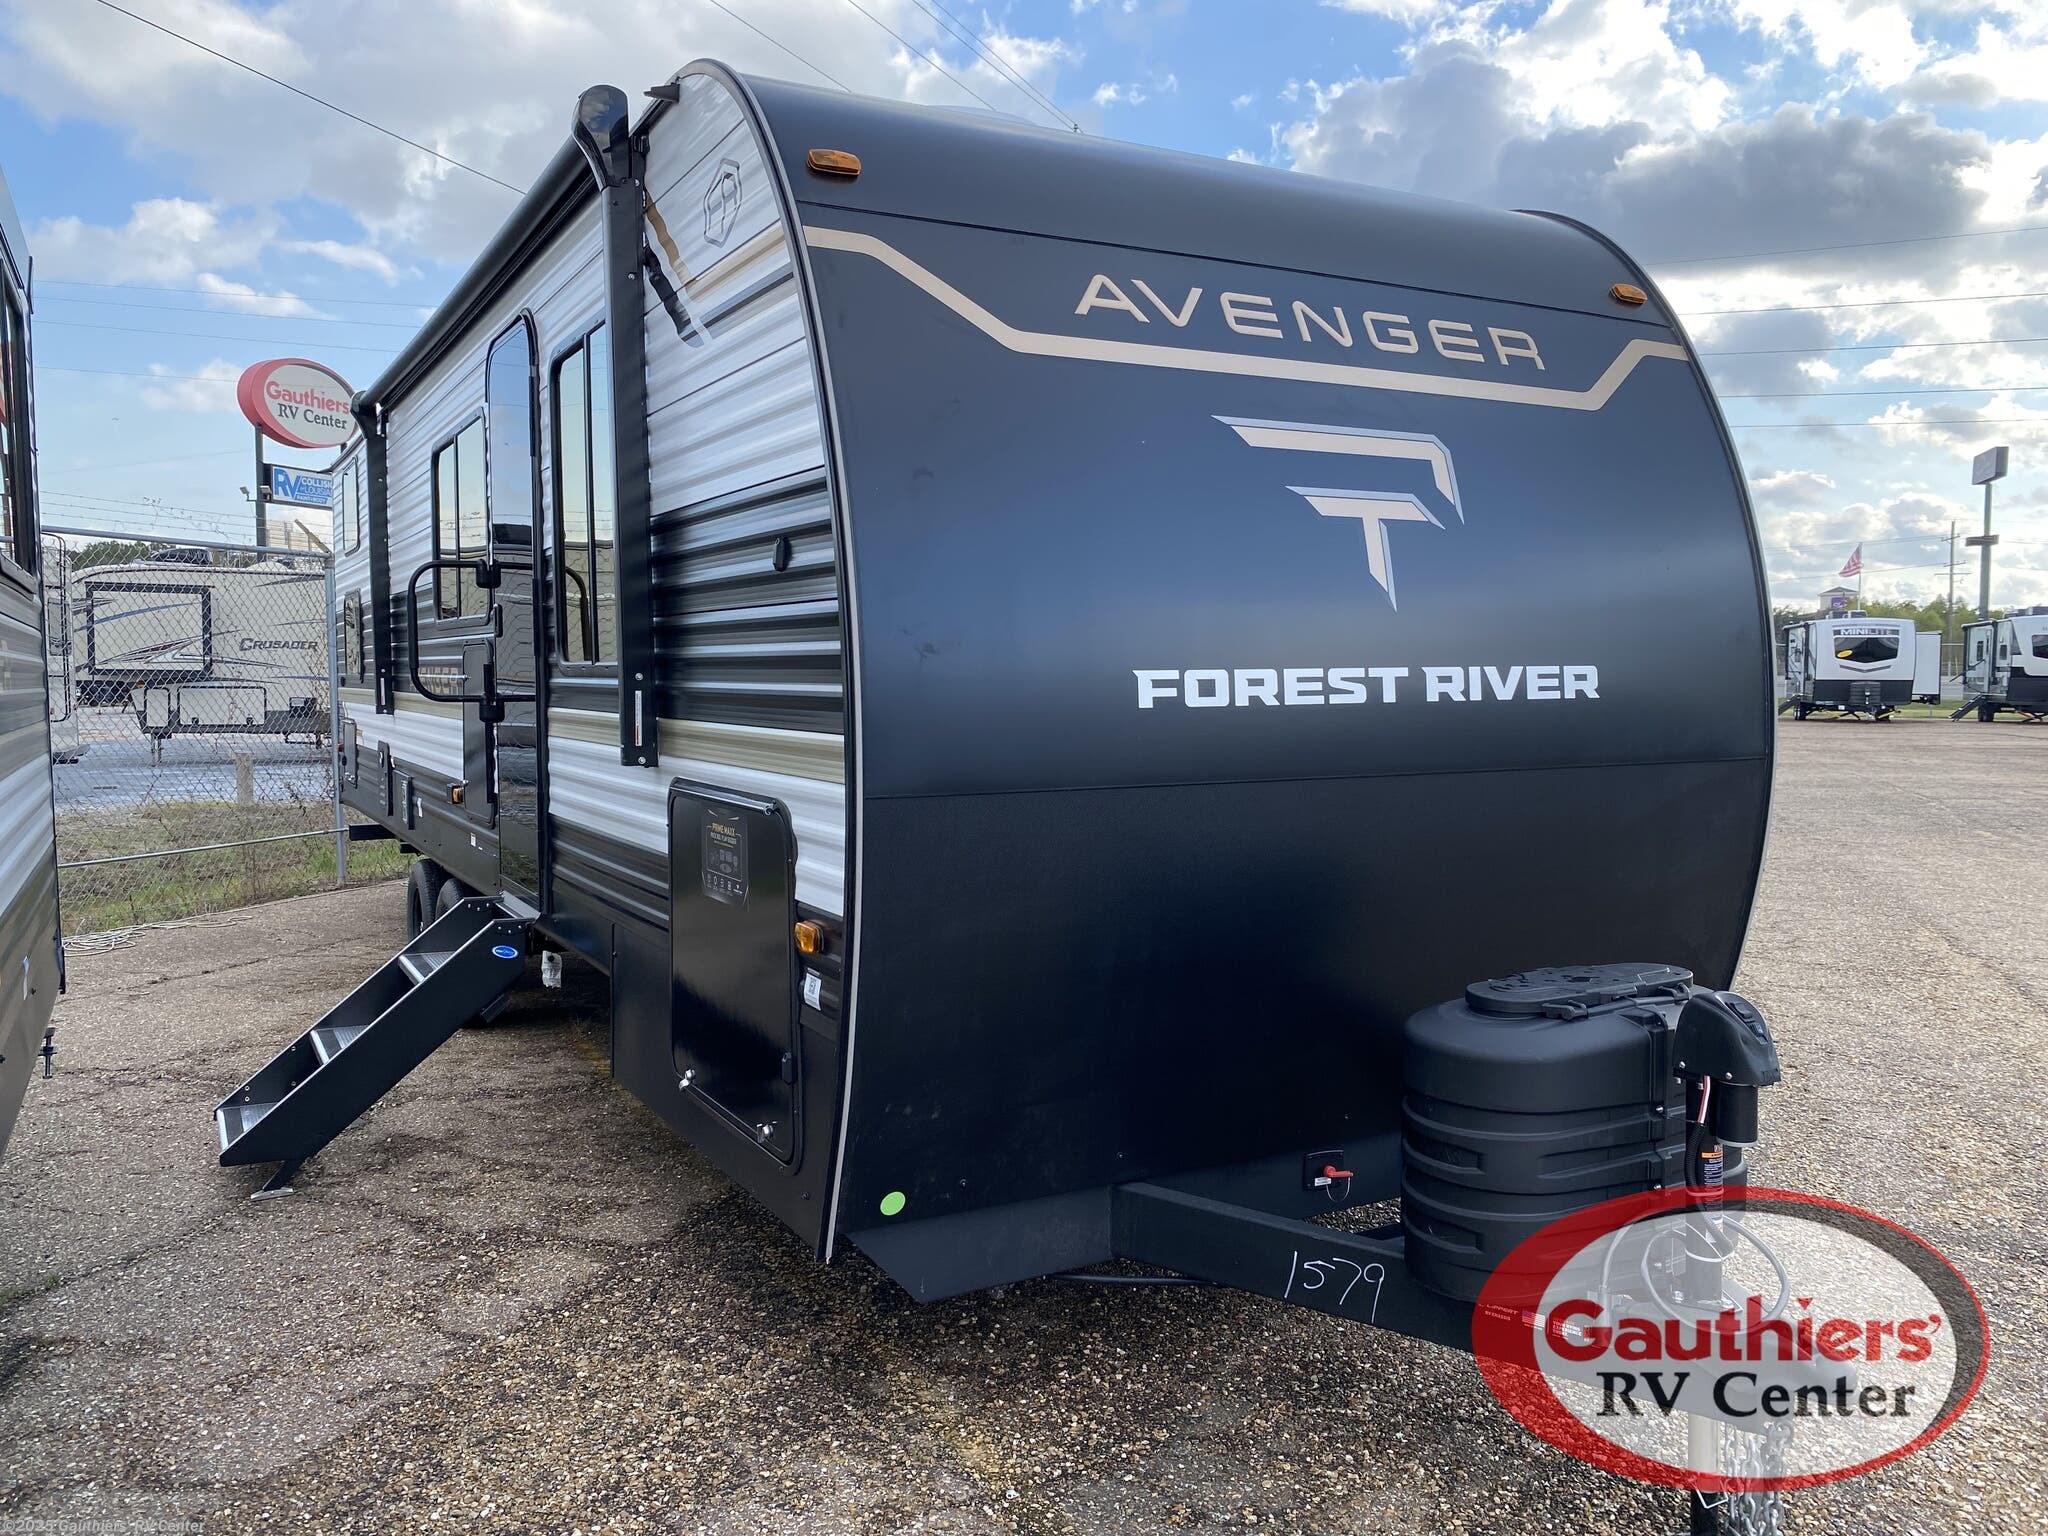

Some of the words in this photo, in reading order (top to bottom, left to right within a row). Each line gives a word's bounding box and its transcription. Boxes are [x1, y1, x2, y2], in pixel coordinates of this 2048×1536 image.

[1074, 274, 1546, 371] AVENGER
[277, 403, 300, 420] RV
[303, 409, 348, 430] Center
[273, 467, 301, 499] RV
[239, 637, 319, 652] CRUSADER
[1132, 667, 1409, 709] FOREST
[1420, 665, 1600, 702] RIVER
[1284, 1250, 1385, 1324] 1579
